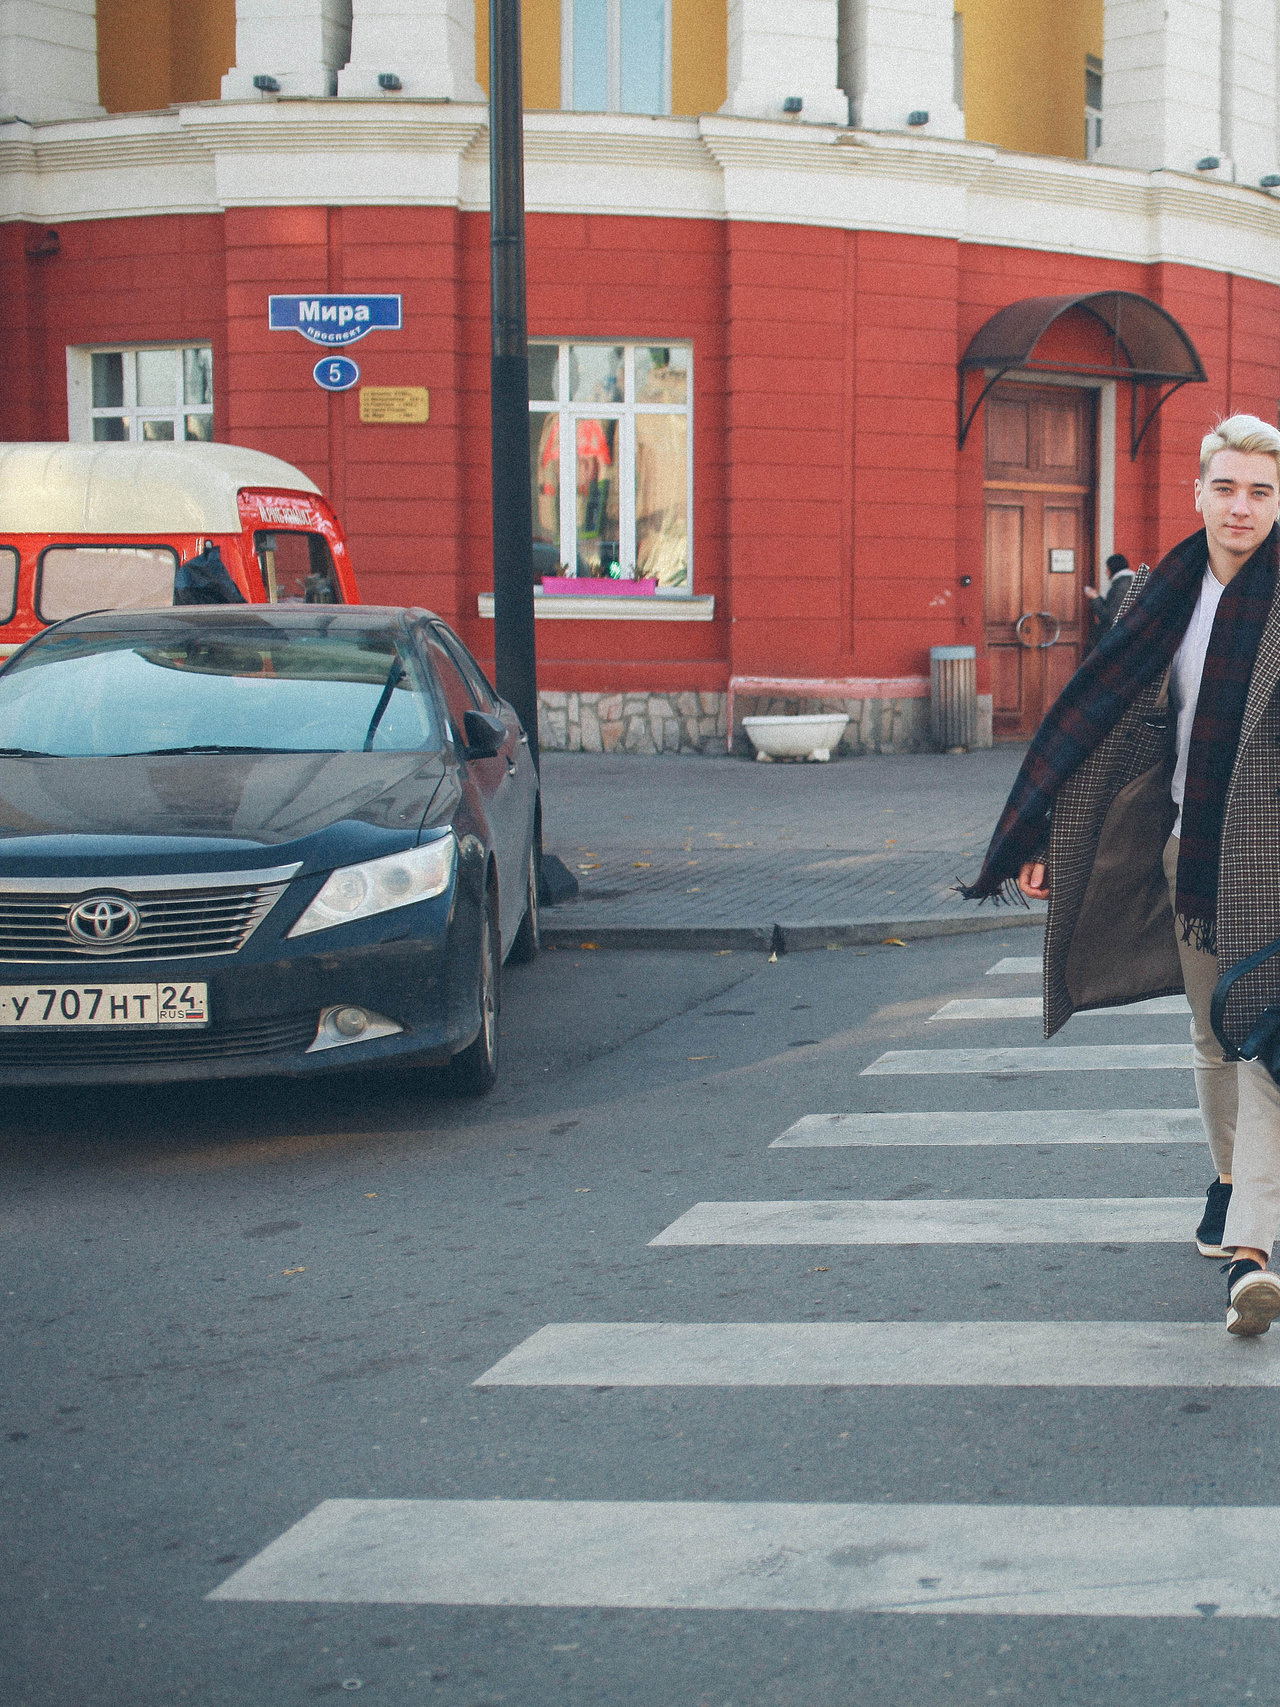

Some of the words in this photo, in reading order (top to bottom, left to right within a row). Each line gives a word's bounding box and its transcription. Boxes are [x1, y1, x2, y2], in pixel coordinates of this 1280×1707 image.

[299, 301, 370, 326] Мира
[307, 326, 361, 342] проспект
[329, 363, 341, 383] 5
[162, 985, 195, 1010] 24
[159, 1011, 185, 1019] RUS
